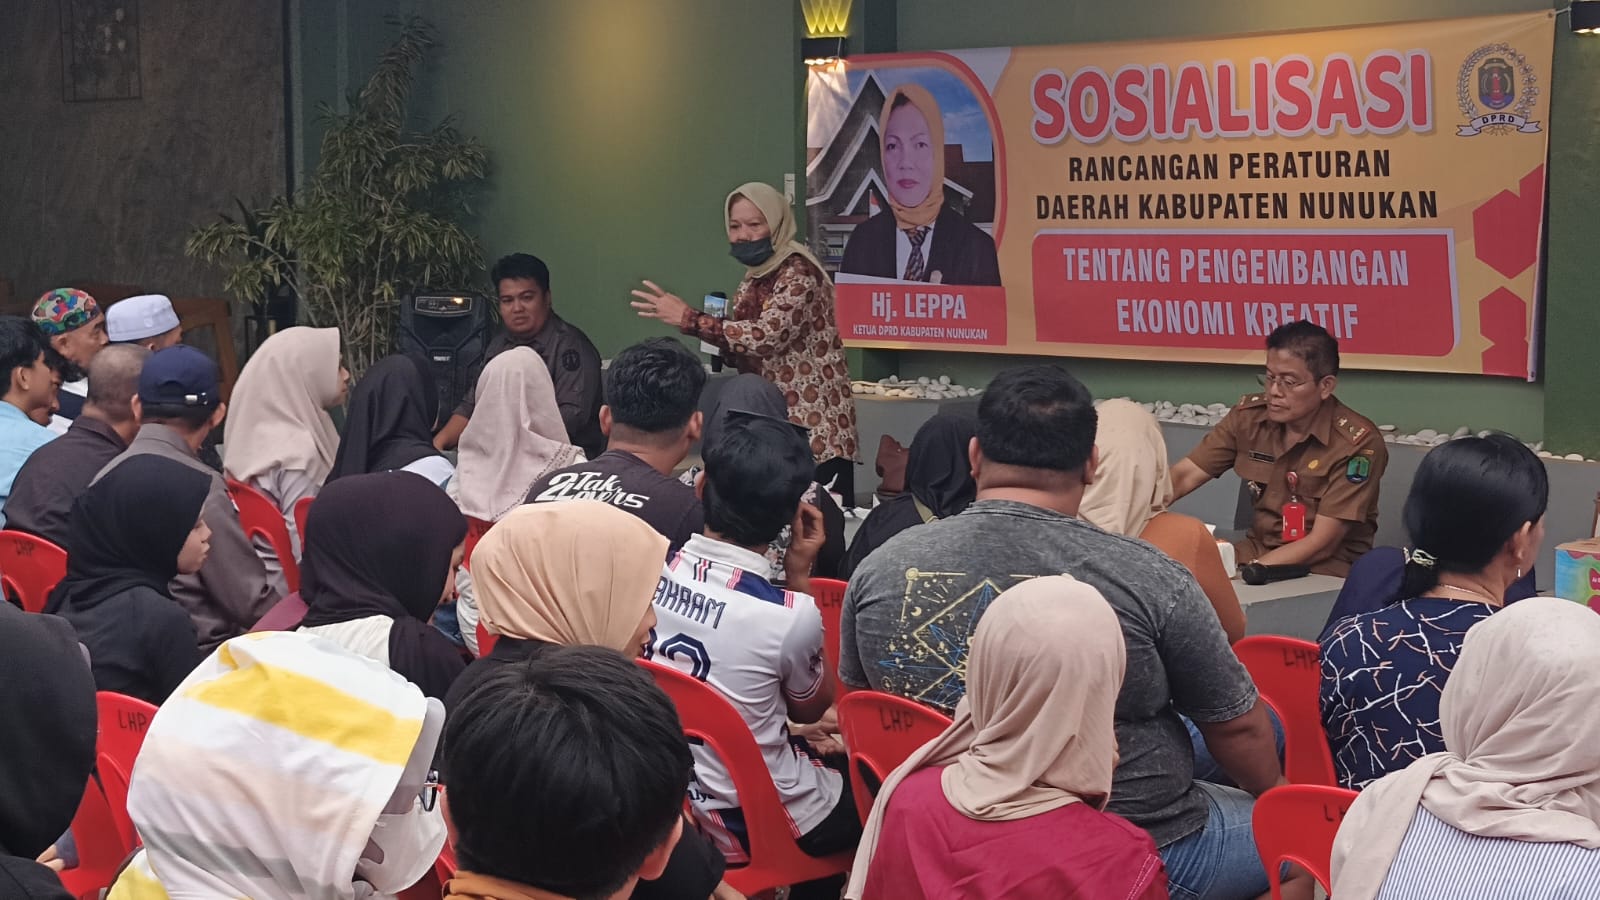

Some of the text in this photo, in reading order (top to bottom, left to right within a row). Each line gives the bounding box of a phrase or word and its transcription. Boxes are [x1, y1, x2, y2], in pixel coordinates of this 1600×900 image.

[1032, 50, 1431, 143] SOSIALISASI
[1482, 115, 1515, 124] DPRD
[1069, 150, 1390, 181] RANCANGAN PERATURAN
[1036, 191, 1438, 219] DAERAH KABUPATEN NUNUKAN
[1063, 248, 1409, 286] TENTANG PENGEMBANGAN
[872, 292, 967, 322] Hj. LEPPA
[1116, 299, 1235, 335] EKONOMI
[853, 324, 988, 339] KETUA DPRD KABUPATEN NUNUKAN
[118, 709, 148, 733] LHP
